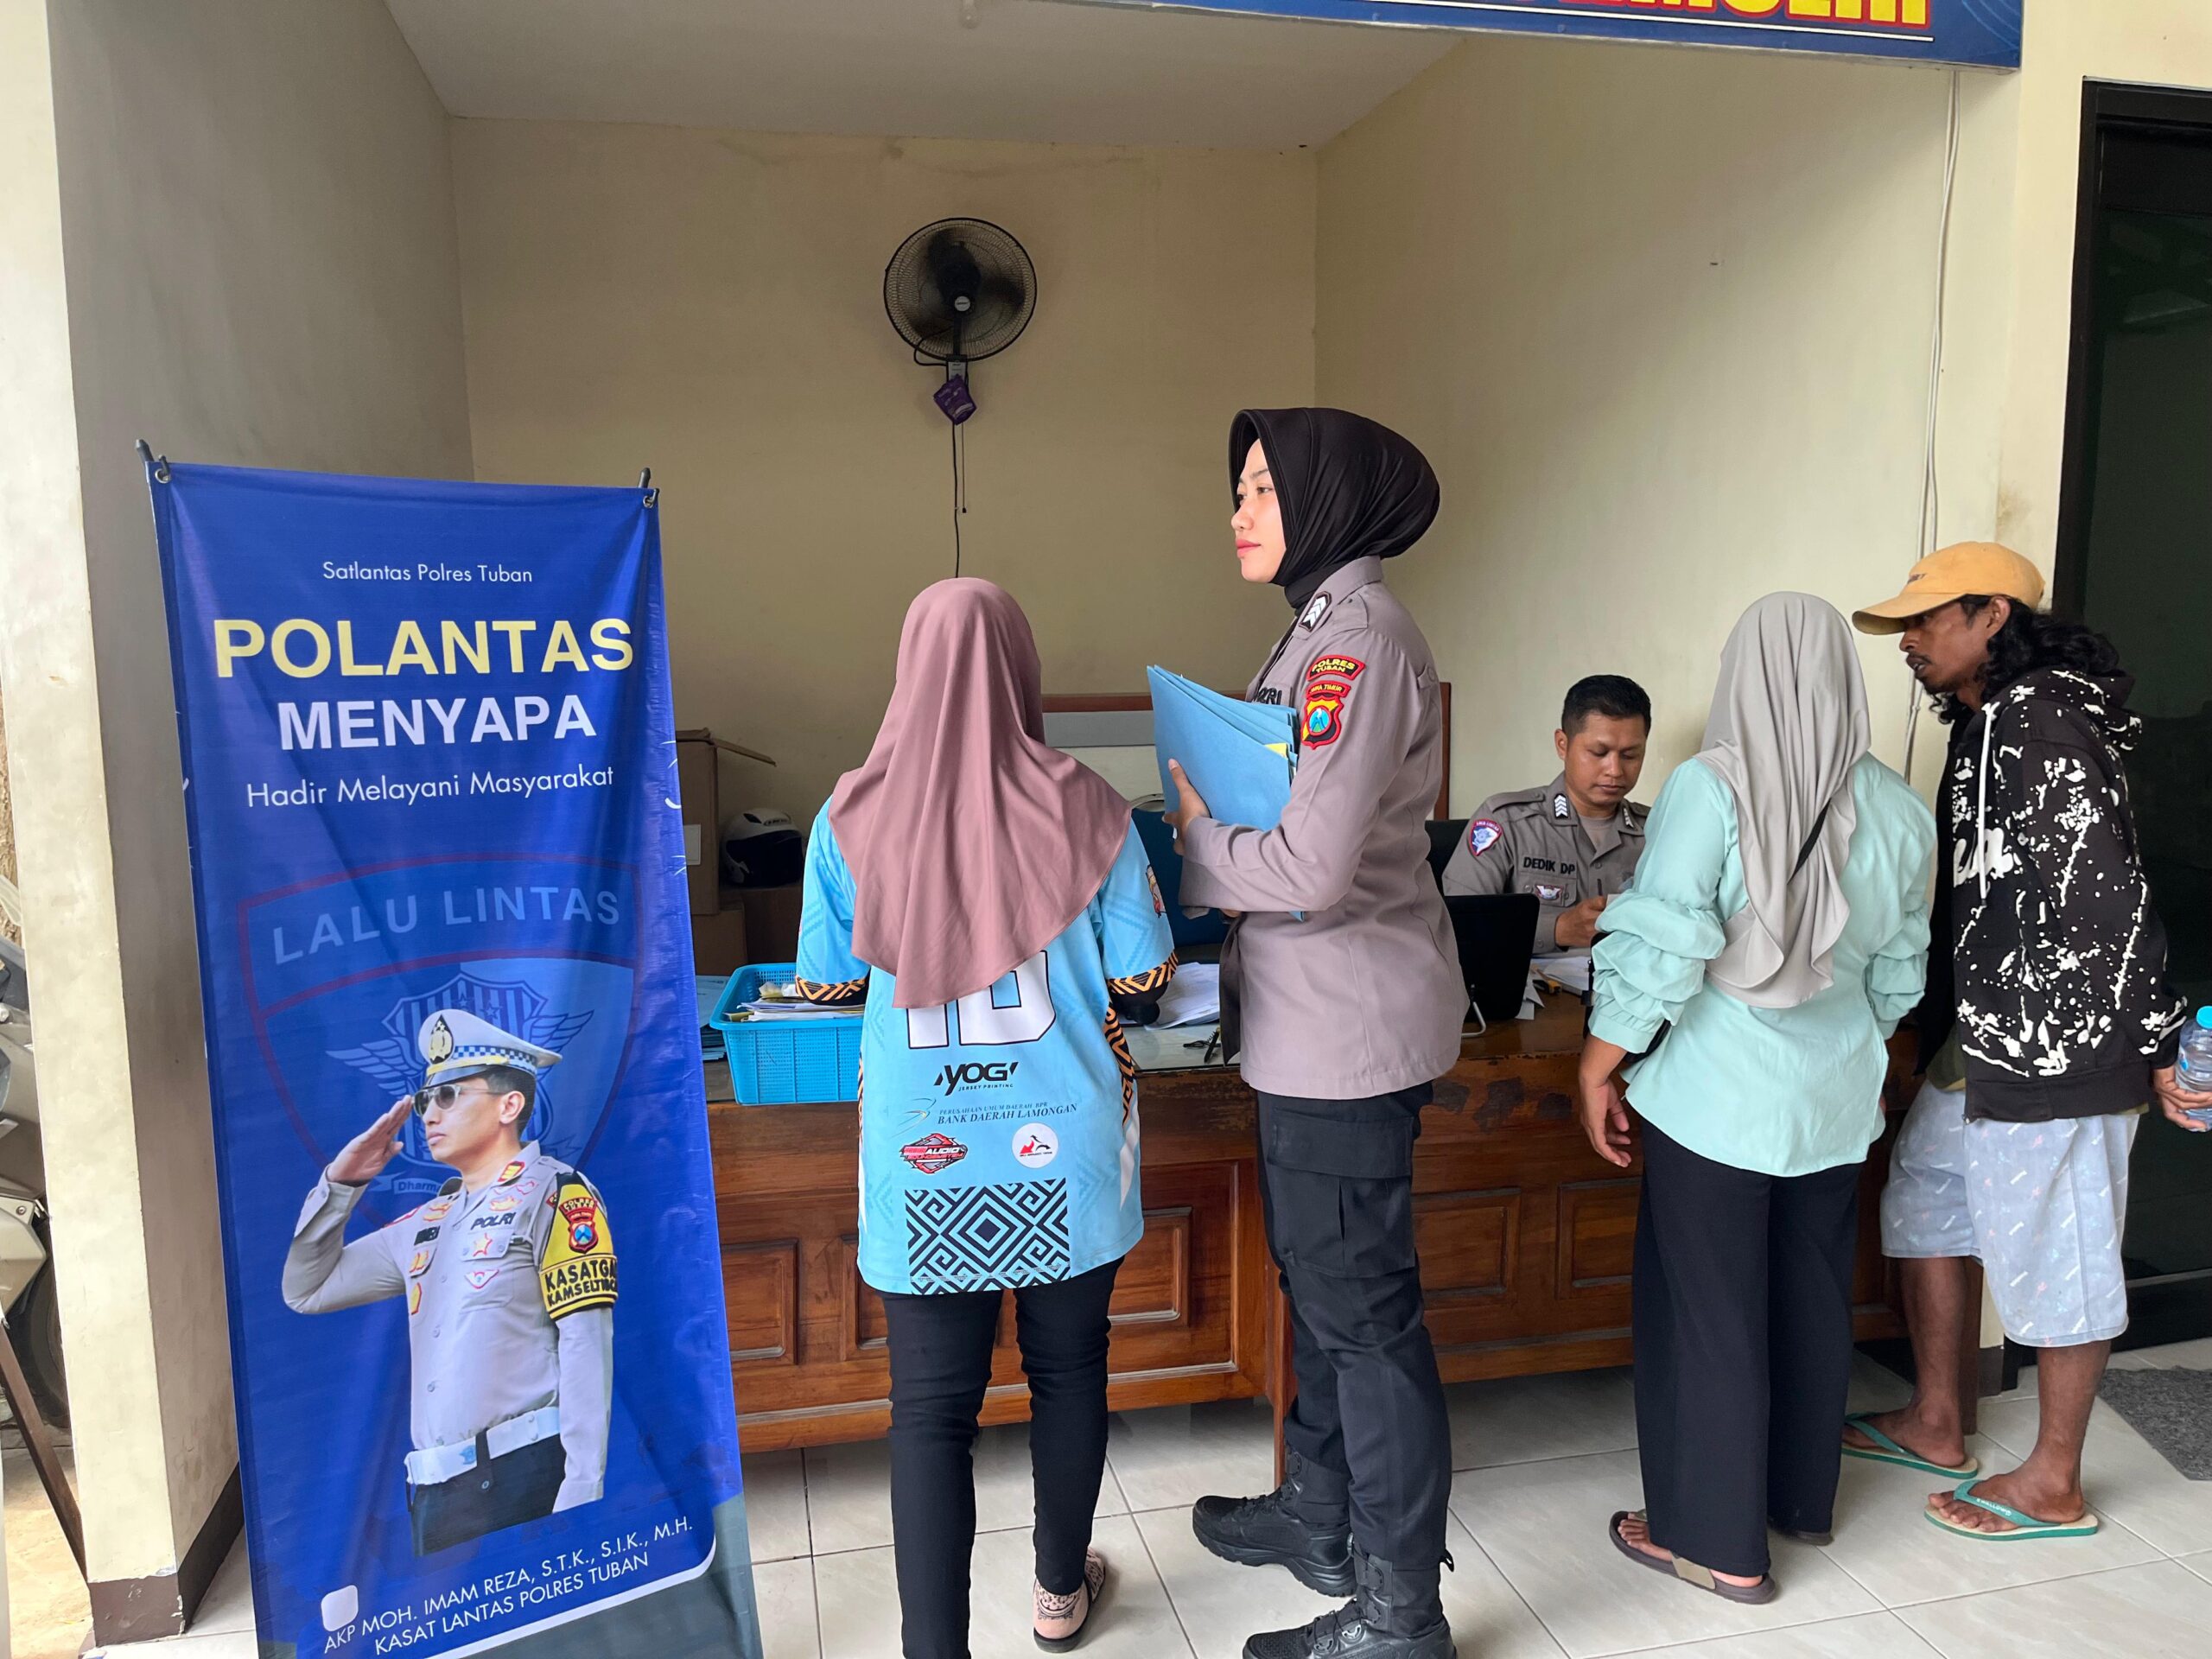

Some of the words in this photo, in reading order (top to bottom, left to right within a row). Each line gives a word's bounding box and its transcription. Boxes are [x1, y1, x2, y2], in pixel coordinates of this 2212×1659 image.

[322, 561, 411, 582] Satlantas
[417, 563, 473, 582] Polres
[477, 563, 532, 582] Tuban
[213, 618, 634, 678] POLANTAS
[1311, 658, 1356, 671] POLRES
[277, 694, 597, 750] MENYAPA
[246, 779, 327, 808] Hadir
[337, 774, 460, 805] Melayani
[469, 763, 614, 798] Masyarakat
[1523, 856, 1556, 872] DEDIK
[1560, 862, 1576, 875] DP
[273, 894, 418, 964] LALU
[443, 886, 620, 925] LINTAS
[938, 1114, 967, 1125] BANK
[969, 1110, 1015, 1122] DAERAH
[1017, 1103, 1078, 1119] LAMONGAN
[939, 1106, 983, 1116] PERUSAHAAN
[925, 1147, 961, 1155] AUDIO
[470, 1211, 517, 1230] POLRI
[323, 1624, 356, 1654] AKP
[361, 1605, 418, 1636] MOH.
[424, 1584, 480, 1616] IMAM
[483, 1567, 536, 1597] REZA,
[541, 1548, 595, 1578] S.T.K.,
[600, 1531, 649, 1557] S.I.K.,
[653, 1515, 694, 1541] M.H.
[374, 1620, 437, 1656] KASAT
[442, 1597, 515, 1634] LANTAS
[519, 1573, 585, 1608] POLRES
[588, 1551, 649, 1585] TUBAN
